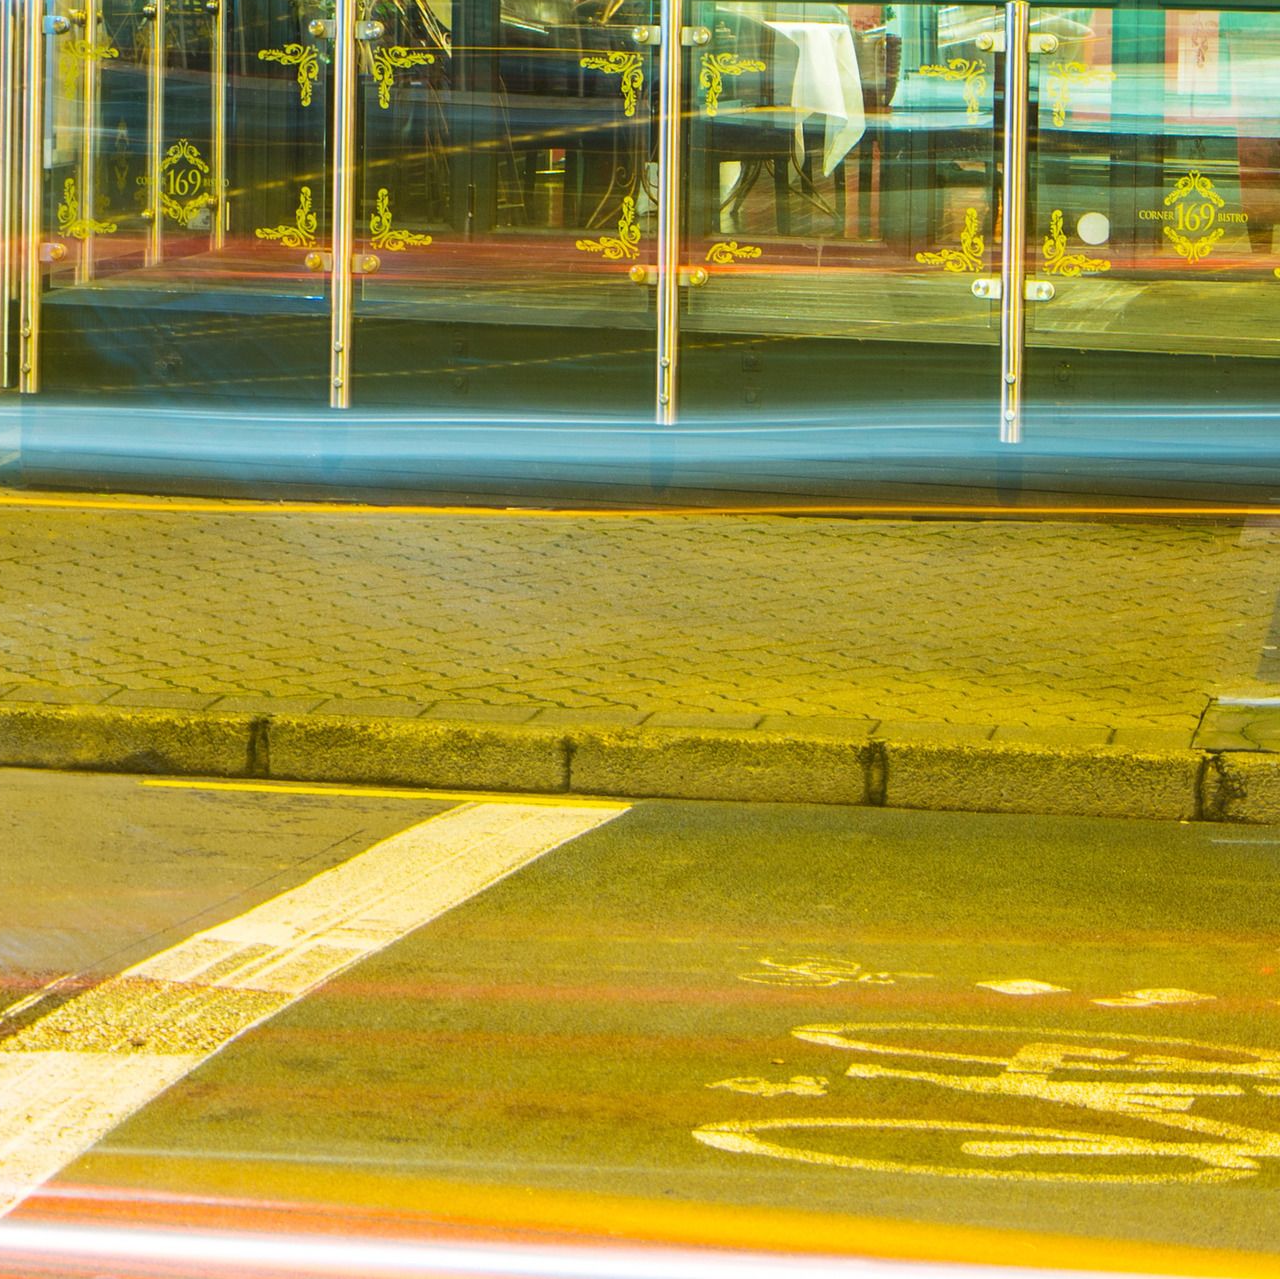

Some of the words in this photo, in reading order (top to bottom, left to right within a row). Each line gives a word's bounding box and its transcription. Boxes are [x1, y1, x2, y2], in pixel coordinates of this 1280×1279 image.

[166, 169, 202, 196] 169
[1138, 209, 1175, 221] CORNER
[1175, 202, 1216, 232] 169
[1217, 213, 1249, 224] BISTRO
